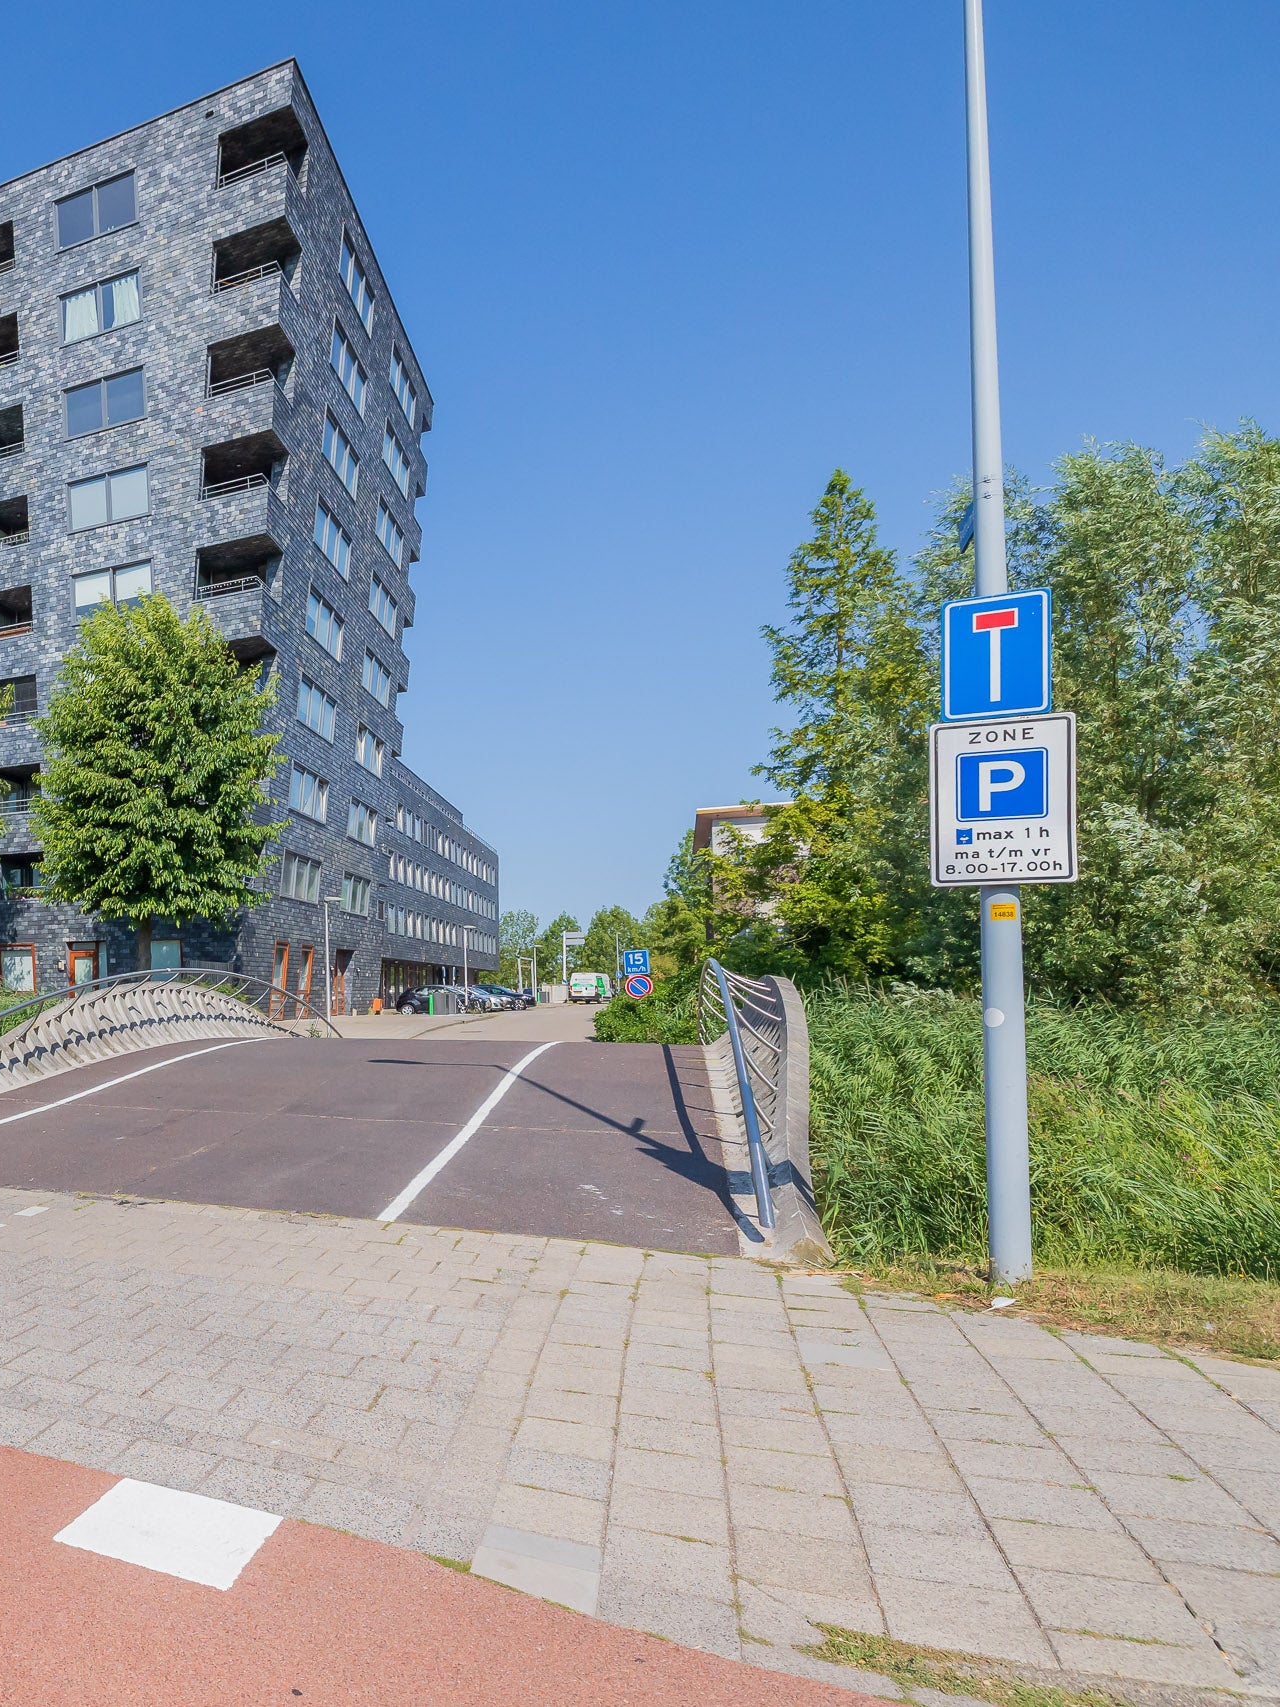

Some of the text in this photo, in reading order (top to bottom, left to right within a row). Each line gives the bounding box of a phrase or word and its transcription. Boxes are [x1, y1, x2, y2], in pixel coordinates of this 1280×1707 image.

[969, 727, 1034, 744] ZONE
[978, 760, 1026, 812] P
[976, 827, 1049, 840] max 1 h
[955, 847, 1051, 859] ma t/m vr
[945, 861, 1062, 874] 8.00-17.00h
[628, 953, 644, 965] 15
